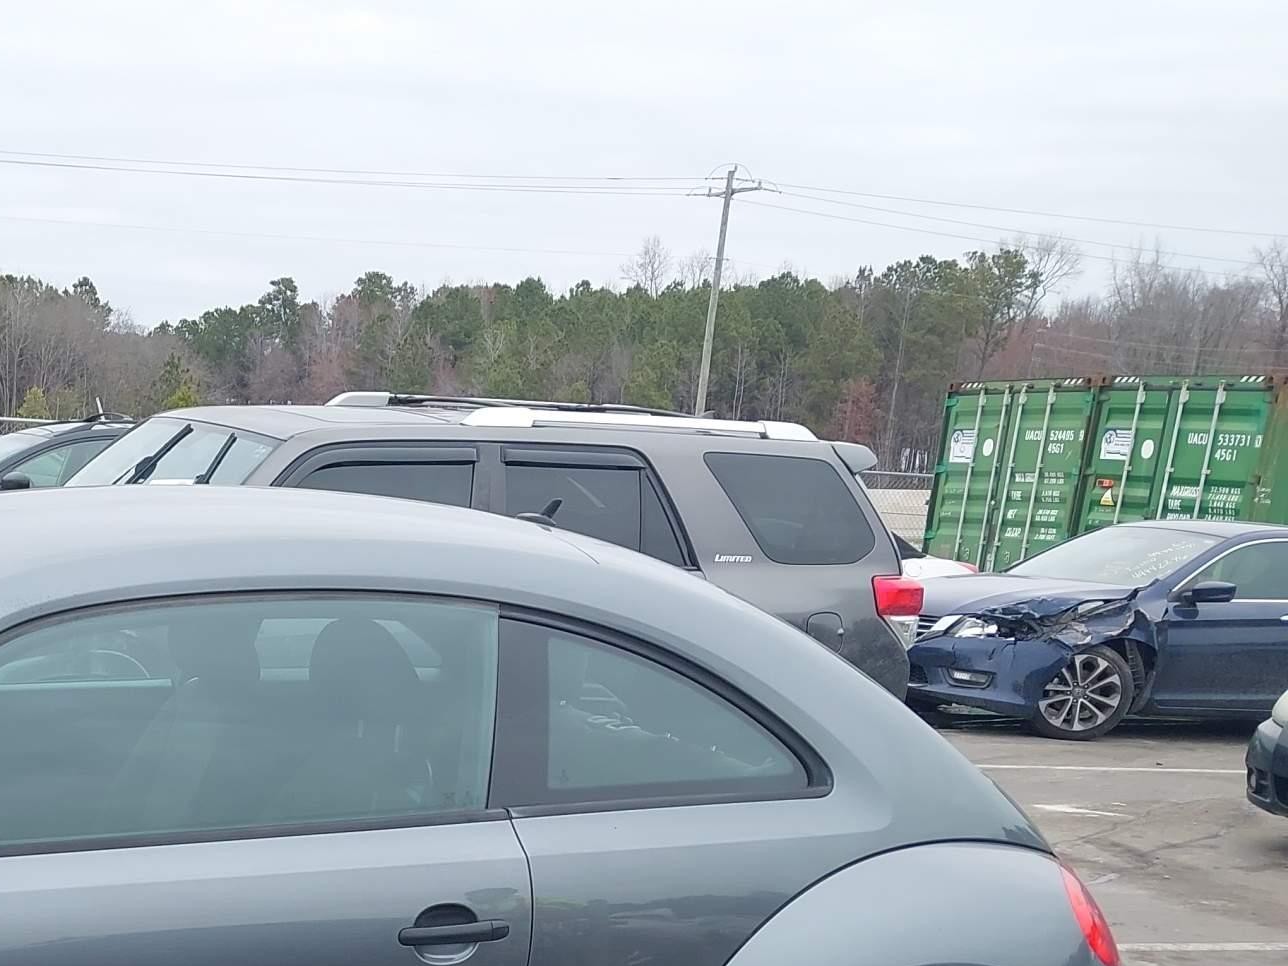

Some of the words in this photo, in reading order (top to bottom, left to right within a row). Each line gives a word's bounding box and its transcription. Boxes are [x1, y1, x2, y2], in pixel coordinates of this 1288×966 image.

[1187, 432, 1209, 445] UACU
[1217, 433, 1251, 447] 533731
[1214, 448, 1237, 461] 45G1
